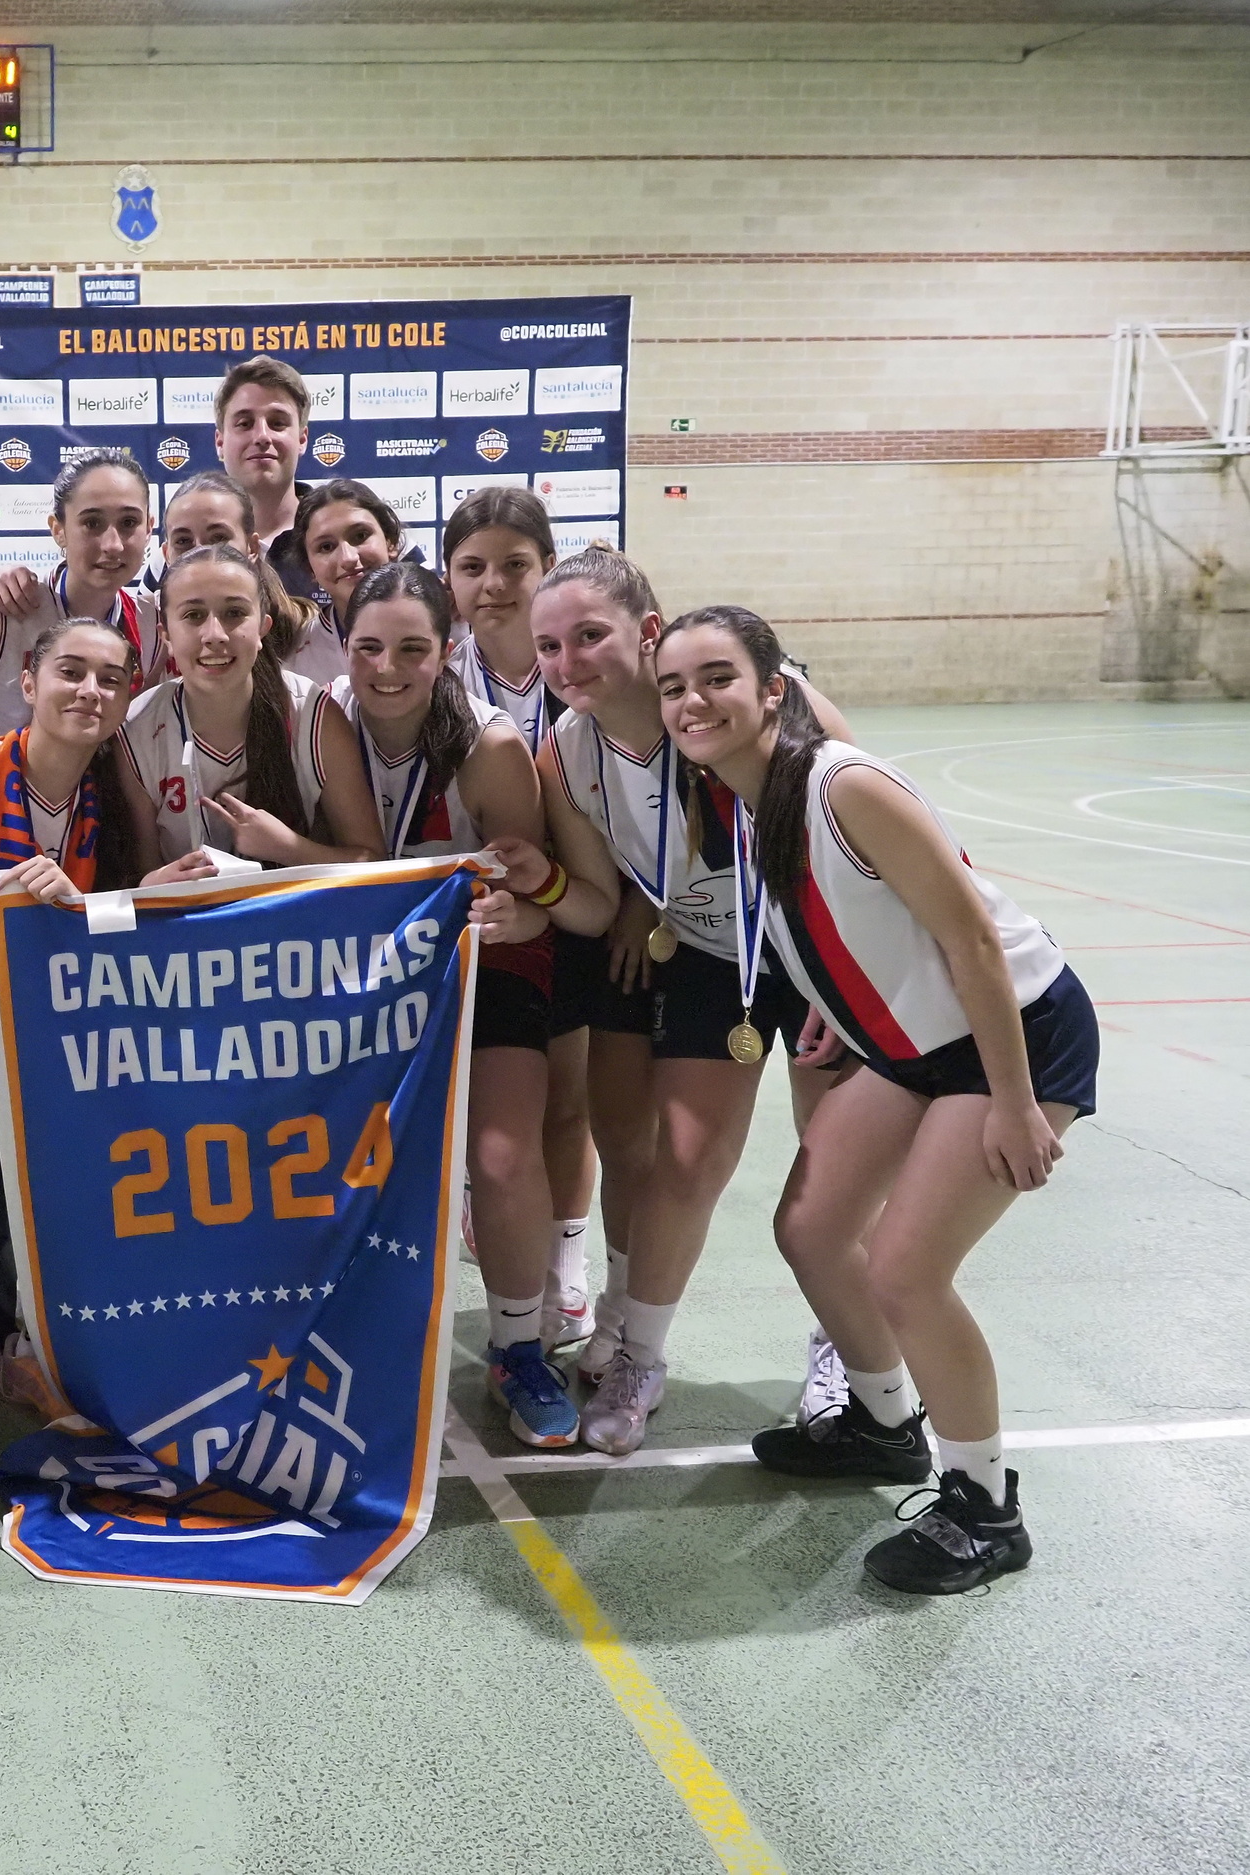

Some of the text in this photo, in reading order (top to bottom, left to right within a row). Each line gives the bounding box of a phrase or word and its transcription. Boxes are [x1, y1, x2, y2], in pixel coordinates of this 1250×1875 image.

[4, 126, 17, 138] 4
[84, 280, 136, 291] CAMPEONES
[0, 292, 49, 302] VALLADOLID
[86, 291, 136, 302] VALLADOLID
[60, 321, 446, 354] EL BALONCESTO ESTÁ EN TU COLE
[500, 323, 608, 341] @COPACOLEGIAL
[449, 388, 514, 402] Herbalife
[77, 396, 144, 412] Herbalife
[484, 433, 501, 441] COPA
[312, 445, 345, 454] COLEGIAL
[475, 440, 509, 449] COLEGIAL
[157, 448, 190, 457] COLEGIAL
[376, 448, 431, 457] EDUCATION
[49, 918, 440, 1013] CAMPEONAS
[61, 991, 428, 1092] VALLADOLID
[110, 1101, 394, 1238] 2024
